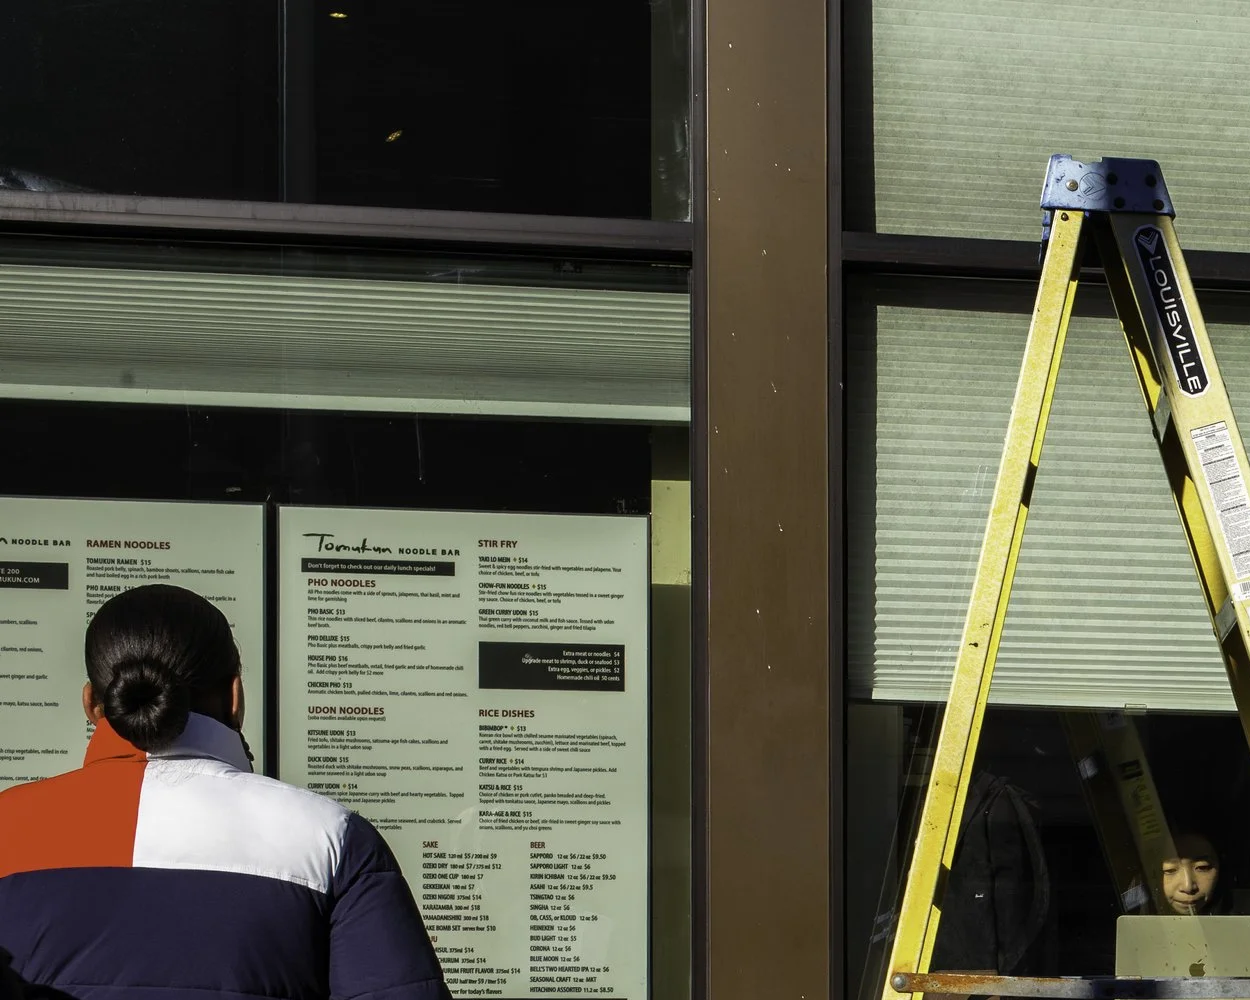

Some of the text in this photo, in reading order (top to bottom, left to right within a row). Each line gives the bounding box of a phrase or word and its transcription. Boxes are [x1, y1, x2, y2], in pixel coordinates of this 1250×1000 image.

[1150, 256, 1201, 393] LOUISVILLE
[86, 540, 170, 550] RAMEN NOODLES
[302, 533, 392, 554] Tomukun
[478, 540, 498, 548] STIR
[384, 564, 396, 572] daily
[331, 579, 376, 587] NOODLES
